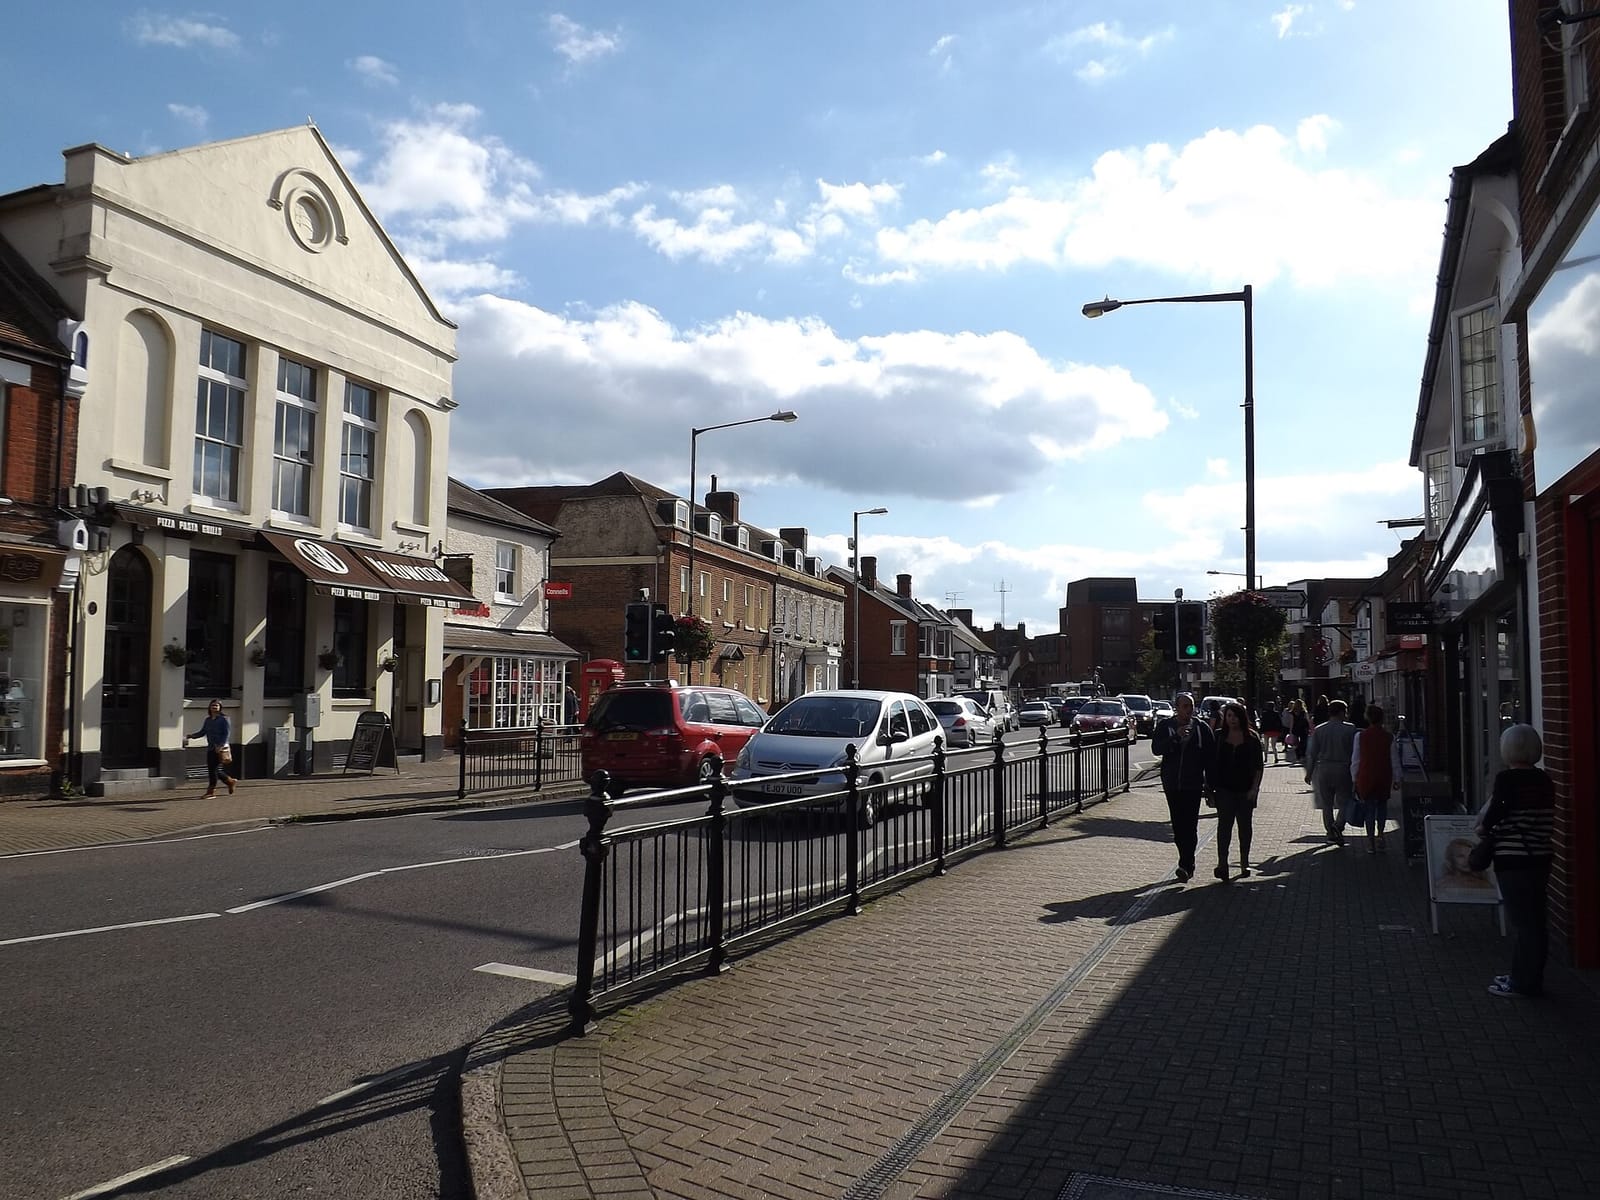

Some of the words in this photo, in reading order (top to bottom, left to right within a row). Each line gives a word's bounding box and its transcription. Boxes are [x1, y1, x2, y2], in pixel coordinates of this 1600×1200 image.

[157, 517, 175, 528] PIZZA
[179, 521, 198, 532] PASTA
[202, 524, 222, 535] GRILLS
